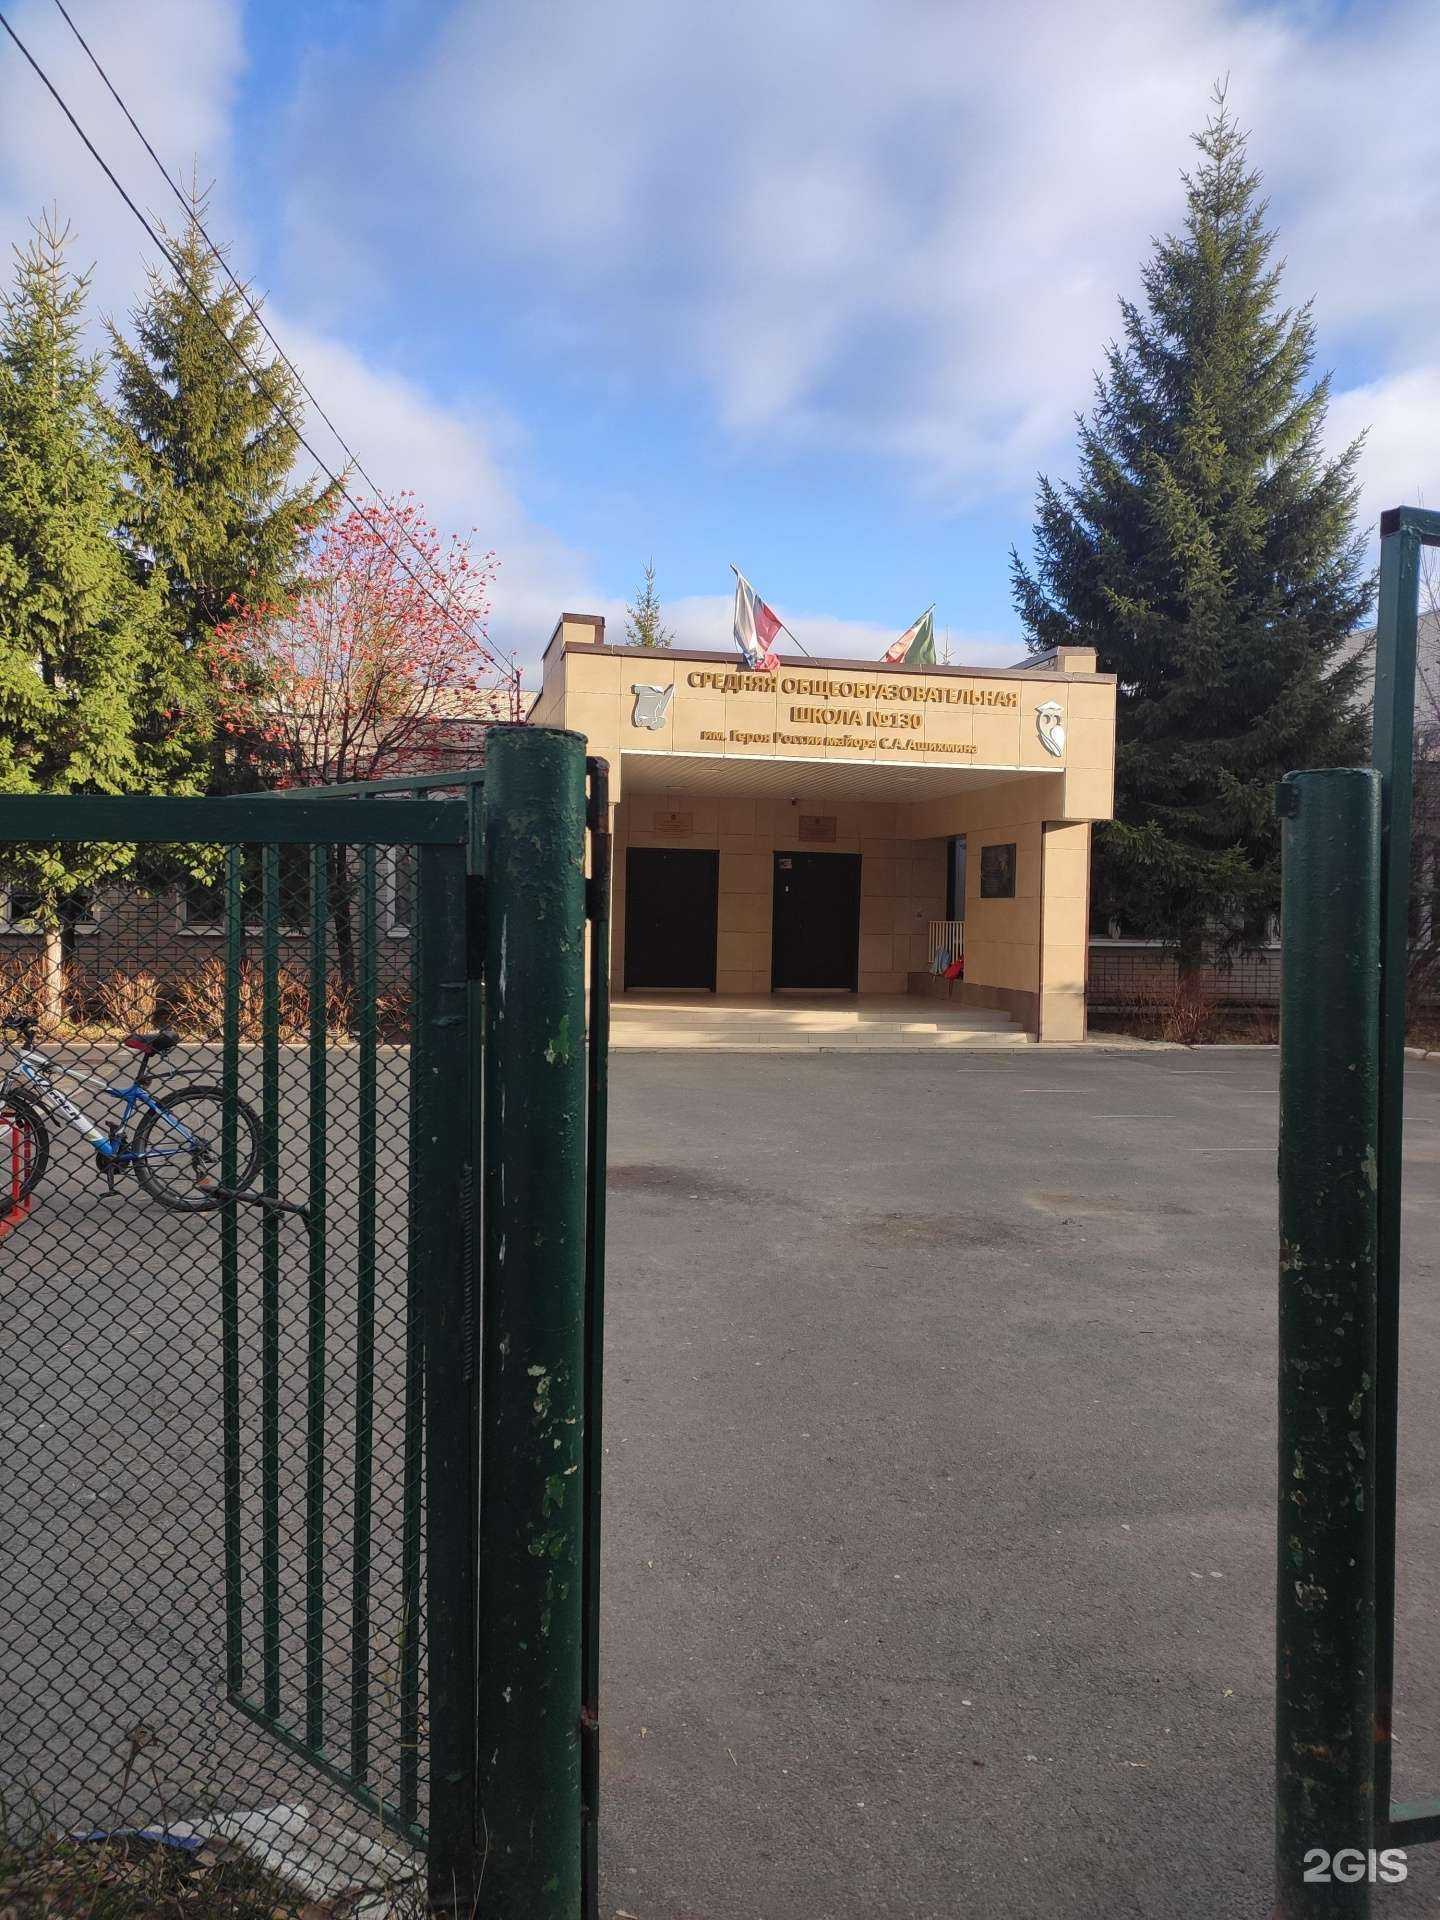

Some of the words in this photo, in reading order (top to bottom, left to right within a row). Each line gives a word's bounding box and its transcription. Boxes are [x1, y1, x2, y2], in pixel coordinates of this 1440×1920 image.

[687, 671, 777, 694] СРЕДНЯЯ
[781, 677, 1018, 708] ОБЩЕОБРАЗОВАТЕЛЬНАЯ
[790, 706, 863, 727] ШКОЛА
[866, 711, 923, 729] №130
[700, 730, 727, 742] им.
[729, 729, 770, 745] Героя
[773, 731, 824, 746] России
[824, 734, 877, 750] майора
